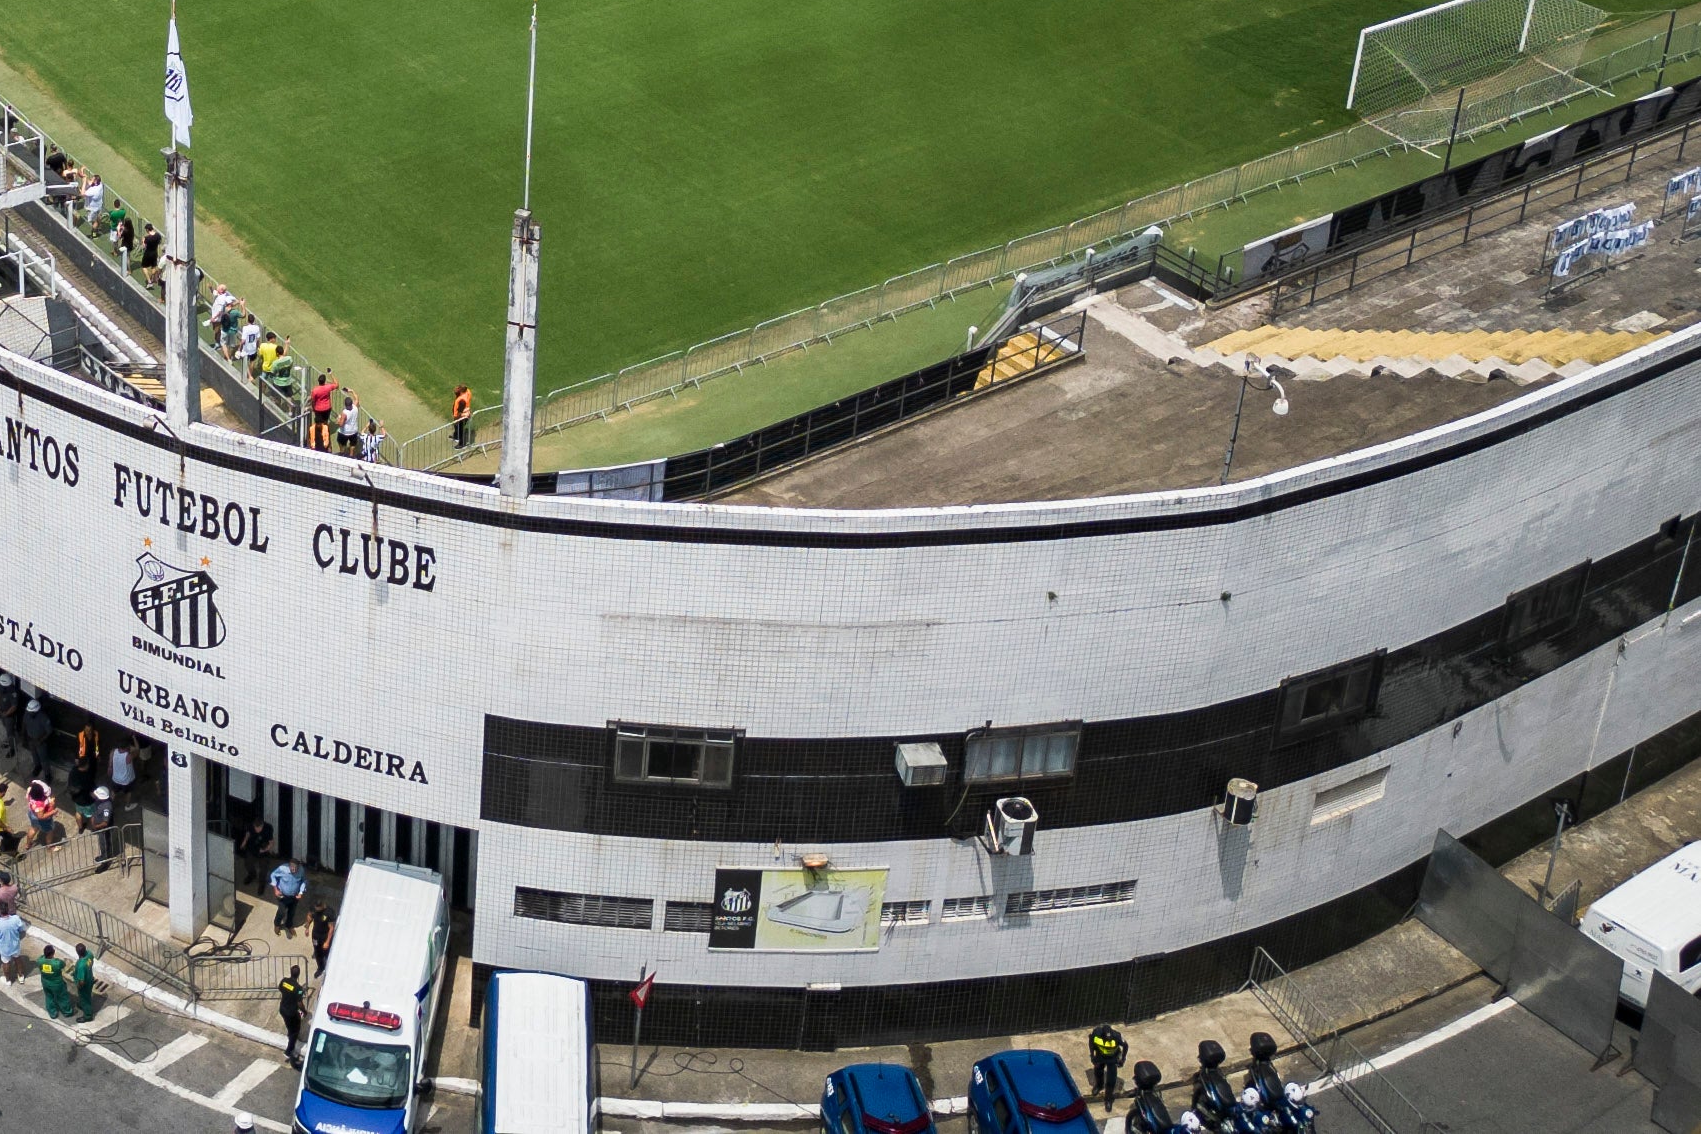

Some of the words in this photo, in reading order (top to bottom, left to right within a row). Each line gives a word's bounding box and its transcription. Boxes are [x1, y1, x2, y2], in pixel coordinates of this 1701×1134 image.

[113, 463, 270, 554] FUTEBOL
[313, 523, 437, 593] CLUBE
[137, 576, 208, 610] S.F.C.
[132, 635, 226, 679] BIMUNDIAL
[117, 669, 230, 729] URBANO
[269, 723, 429, 785] CALDEIRA
[120, 701, 156, 728] Vila
[160, 718, 239, 757] Belmiro
